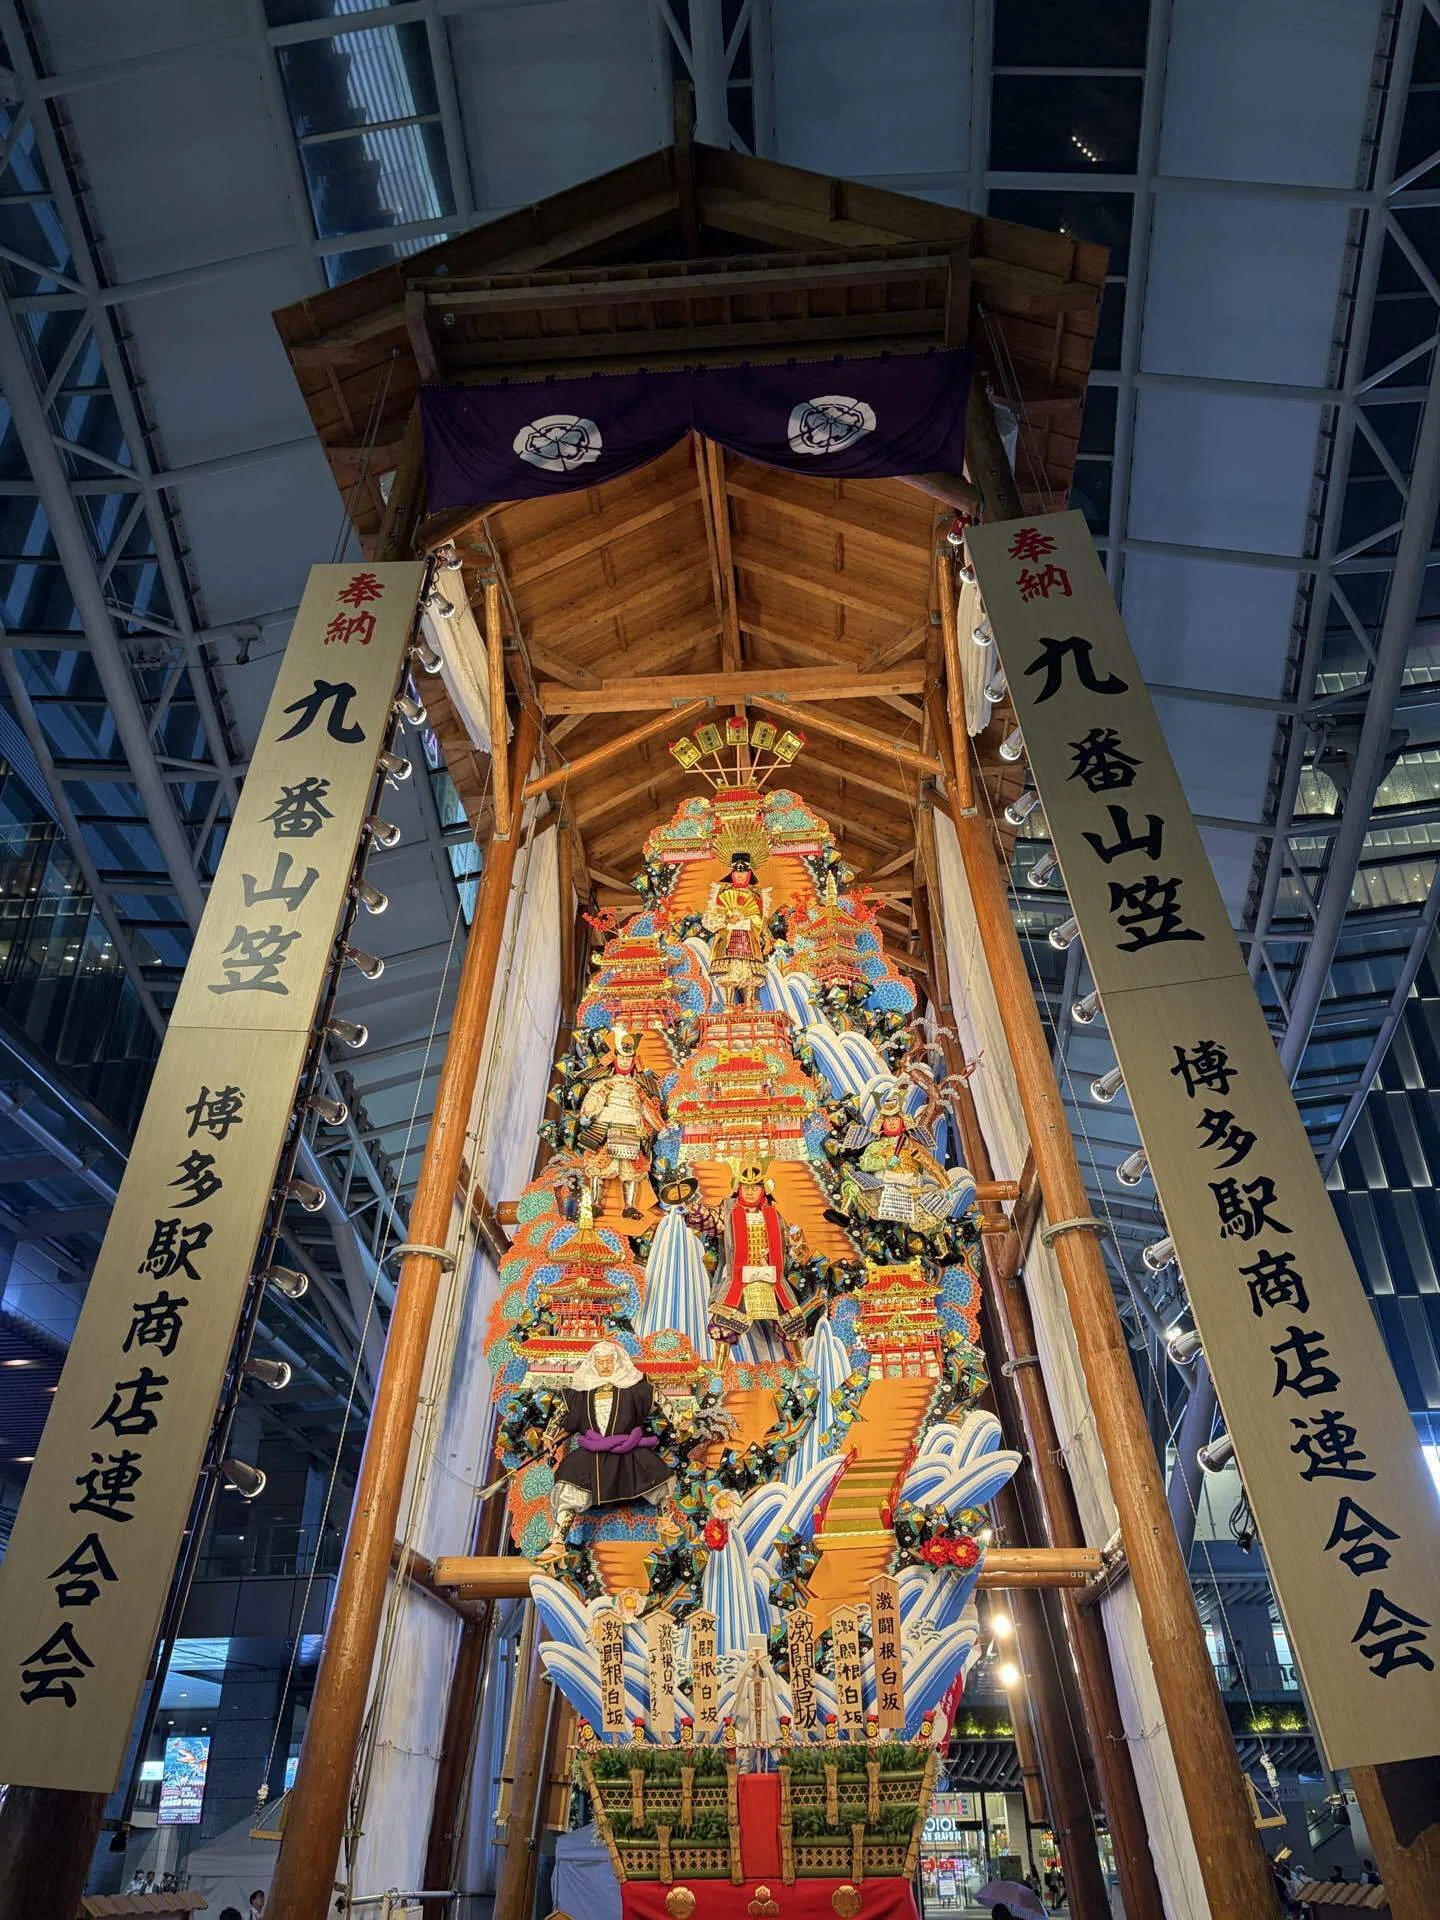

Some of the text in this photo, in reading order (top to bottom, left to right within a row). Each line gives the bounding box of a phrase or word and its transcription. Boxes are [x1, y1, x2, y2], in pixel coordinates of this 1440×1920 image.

[323, 573, 385, 646] 奉納
[1008, 527, 1073, 603] 奉納
[207, 679, 367, 996] 九番山笠
[1024, 636, 1206, 953] 九番山笠
[19, 1085, 247, 1708] 博多駅商店連合会
[1170, 1040, 1435, 1680] 博多駅商店連合会
[602, 1620, 624, 1726] 激闘根白坂
[697, 1617, 719, 1723] 激闘根白坂
[788, 1614, 818, 1730] 激闘根白坂
[836, 1619, 864, 1725] 激闘根白坂
[876, 1592, 901, 1711] 激闘根白坂
